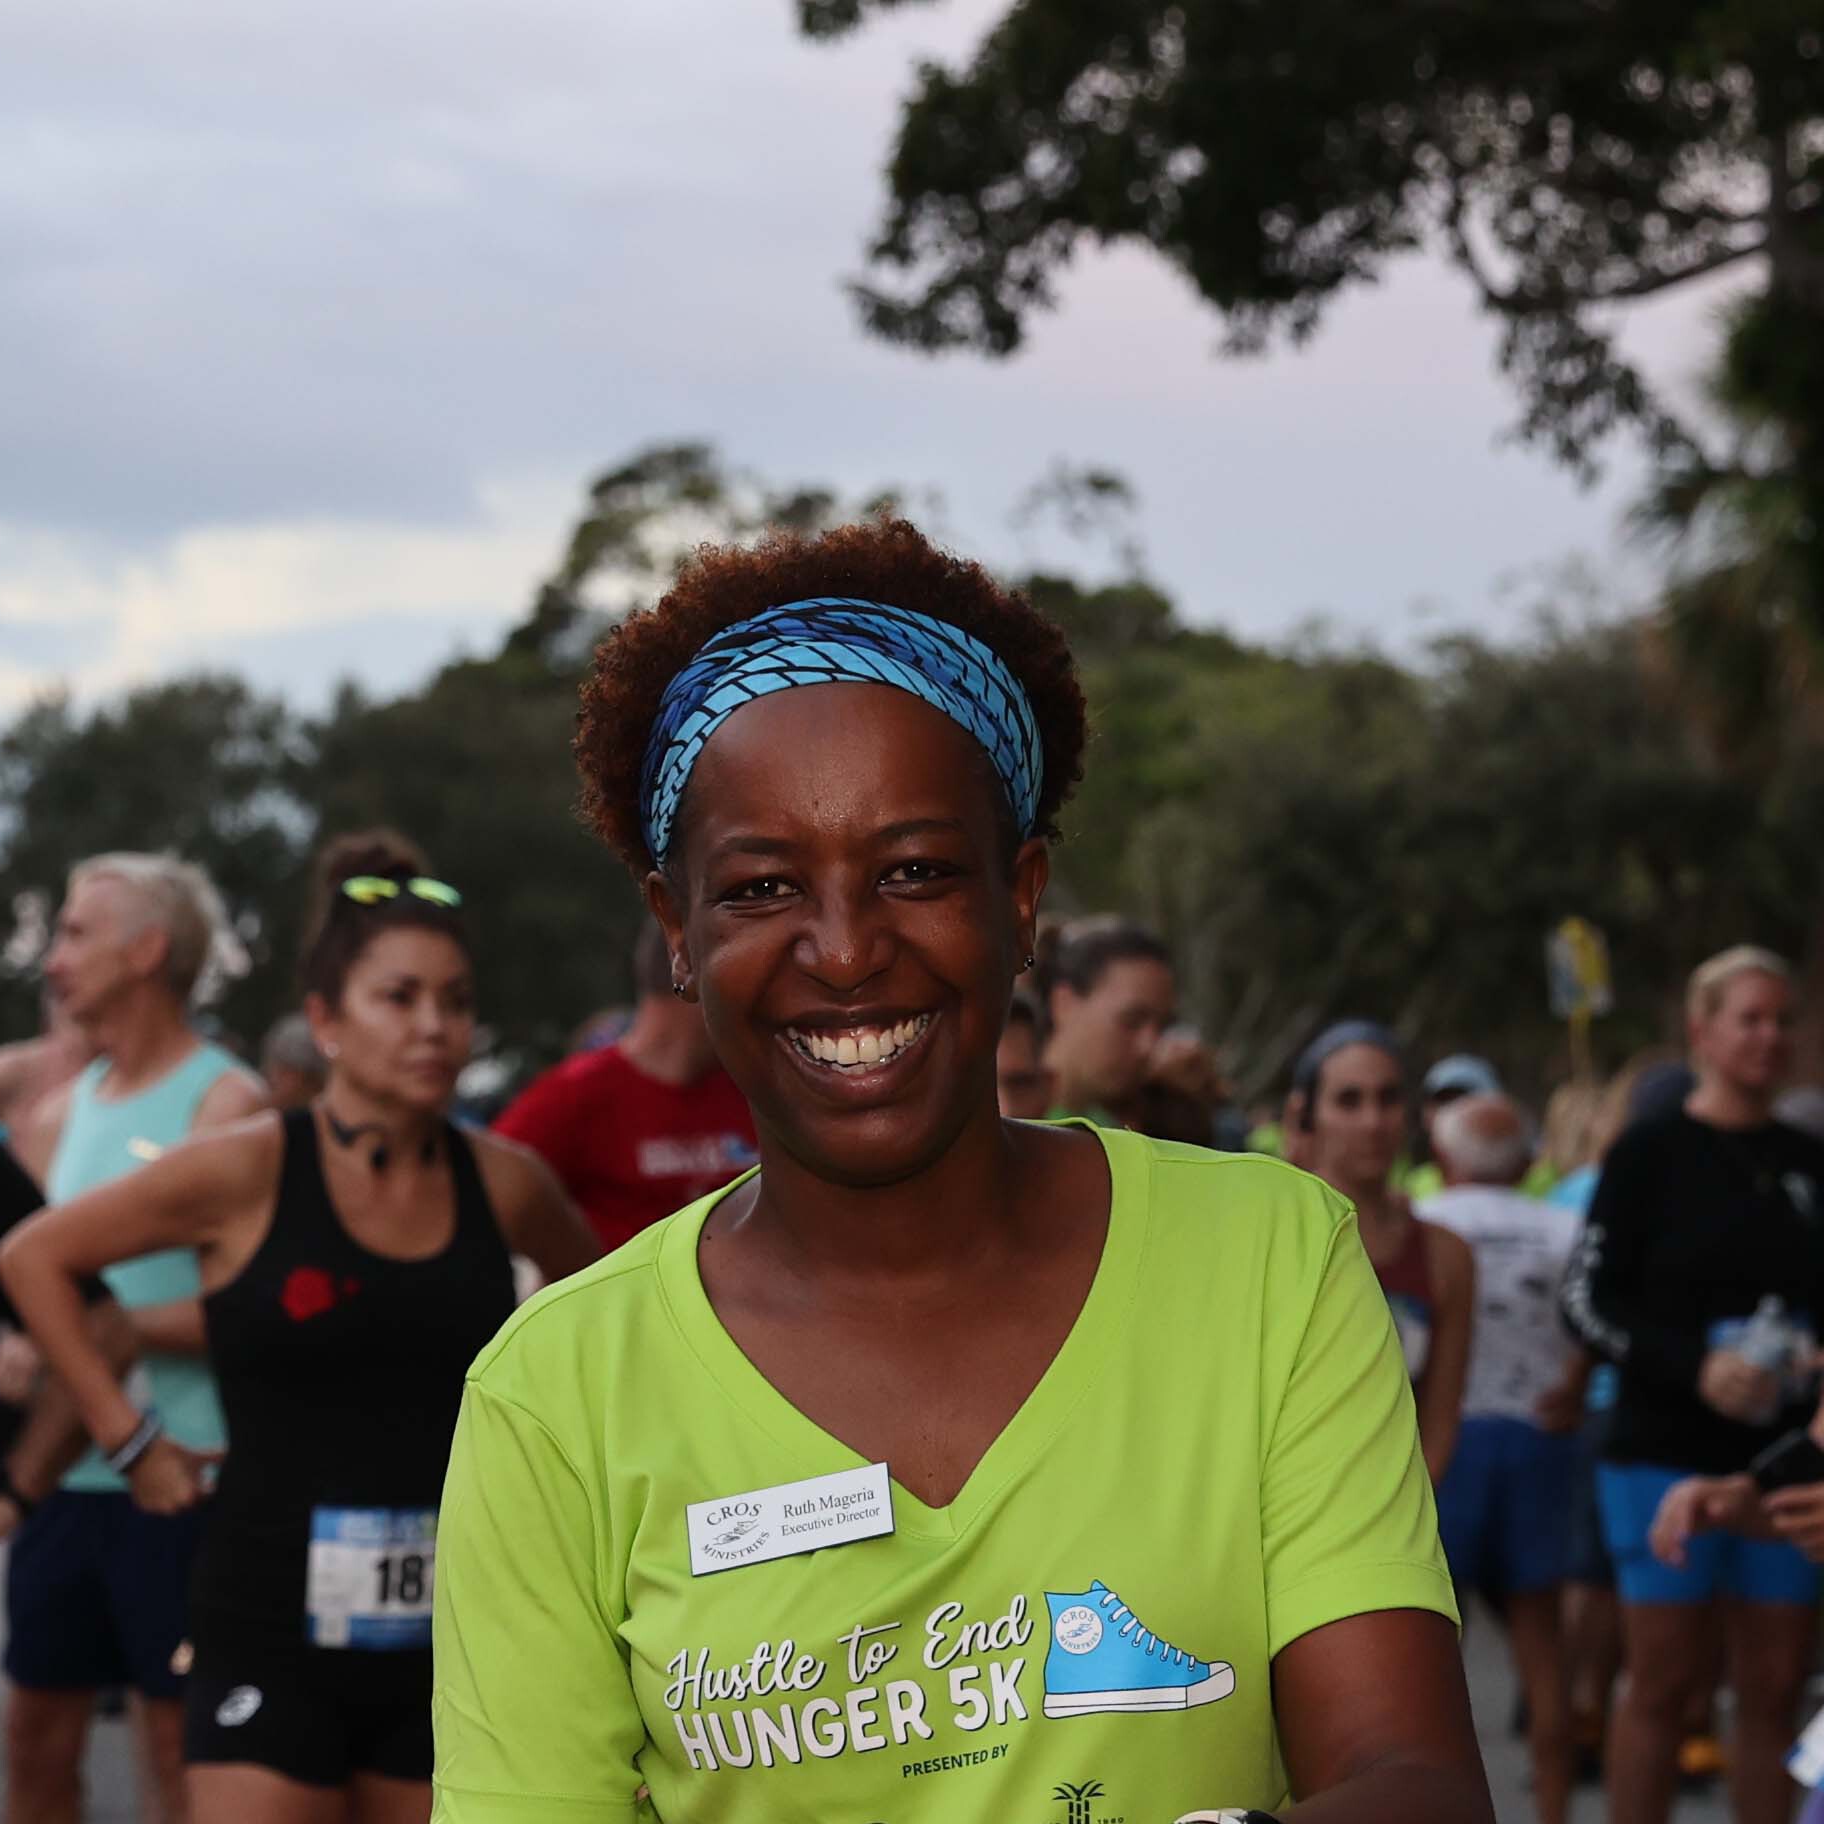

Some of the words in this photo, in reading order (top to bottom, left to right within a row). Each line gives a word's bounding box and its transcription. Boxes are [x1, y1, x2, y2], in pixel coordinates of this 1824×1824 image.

[706, 1502, 763, 1526] CROS
[783, 1500, 816, 1519] Ruth
[819, 1487, 875, 1511] Mageria
[781, 1517, 833, 1537] Executive
[836, 1506, 881, 1525] Director
[701, 1531, 770, 1560] MINISTRIES
[1062, 1610, 1094, 1624] CROS
[663, 1639, 826, 1710] Hustle
[837, 1621, 901, 1683] to
[922, 1594, 1033, 1670] End
[672, 1680, 934, 1771] HUNGER
[948, 1657, 1028, 1732] 5K
[902, 1749, 989, 1778] PRESENTED
[992, 1744, 1009, 1760] BY
